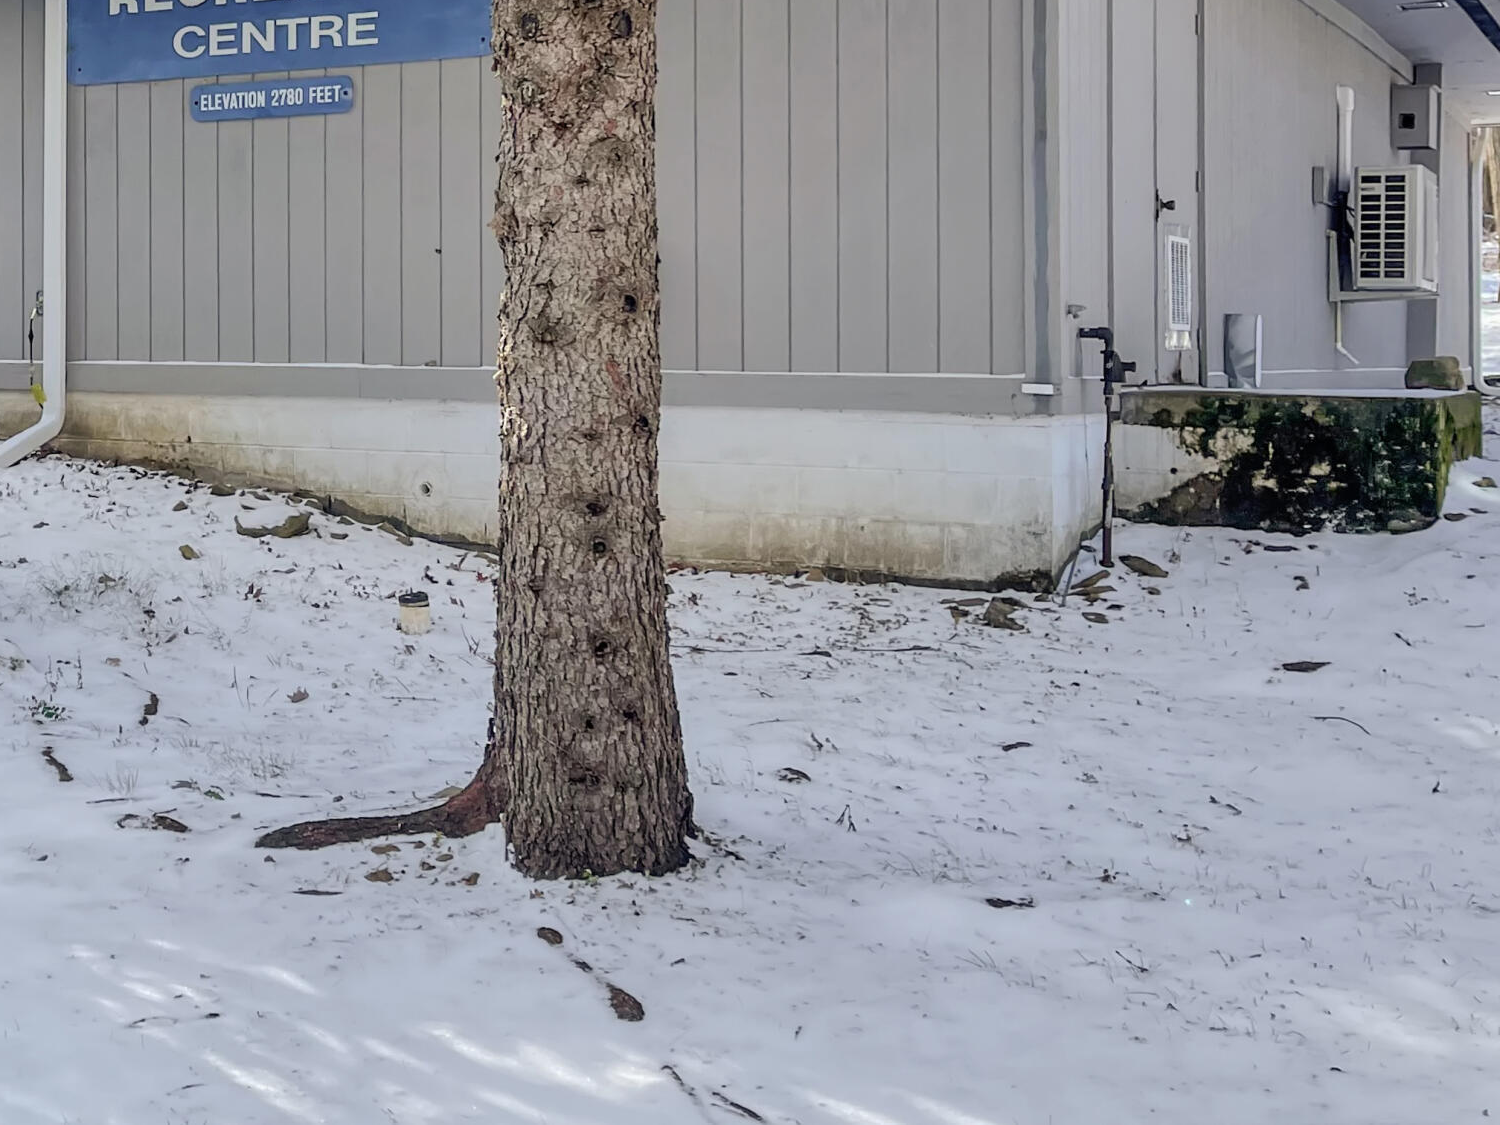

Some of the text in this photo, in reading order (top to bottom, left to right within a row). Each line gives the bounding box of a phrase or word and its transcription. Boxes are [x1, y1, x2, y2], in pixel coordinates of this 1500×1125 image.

[172, 11, 379, 59] CENTRE
[200, 85, 342, 112] ELEVATION 2780 FEET
